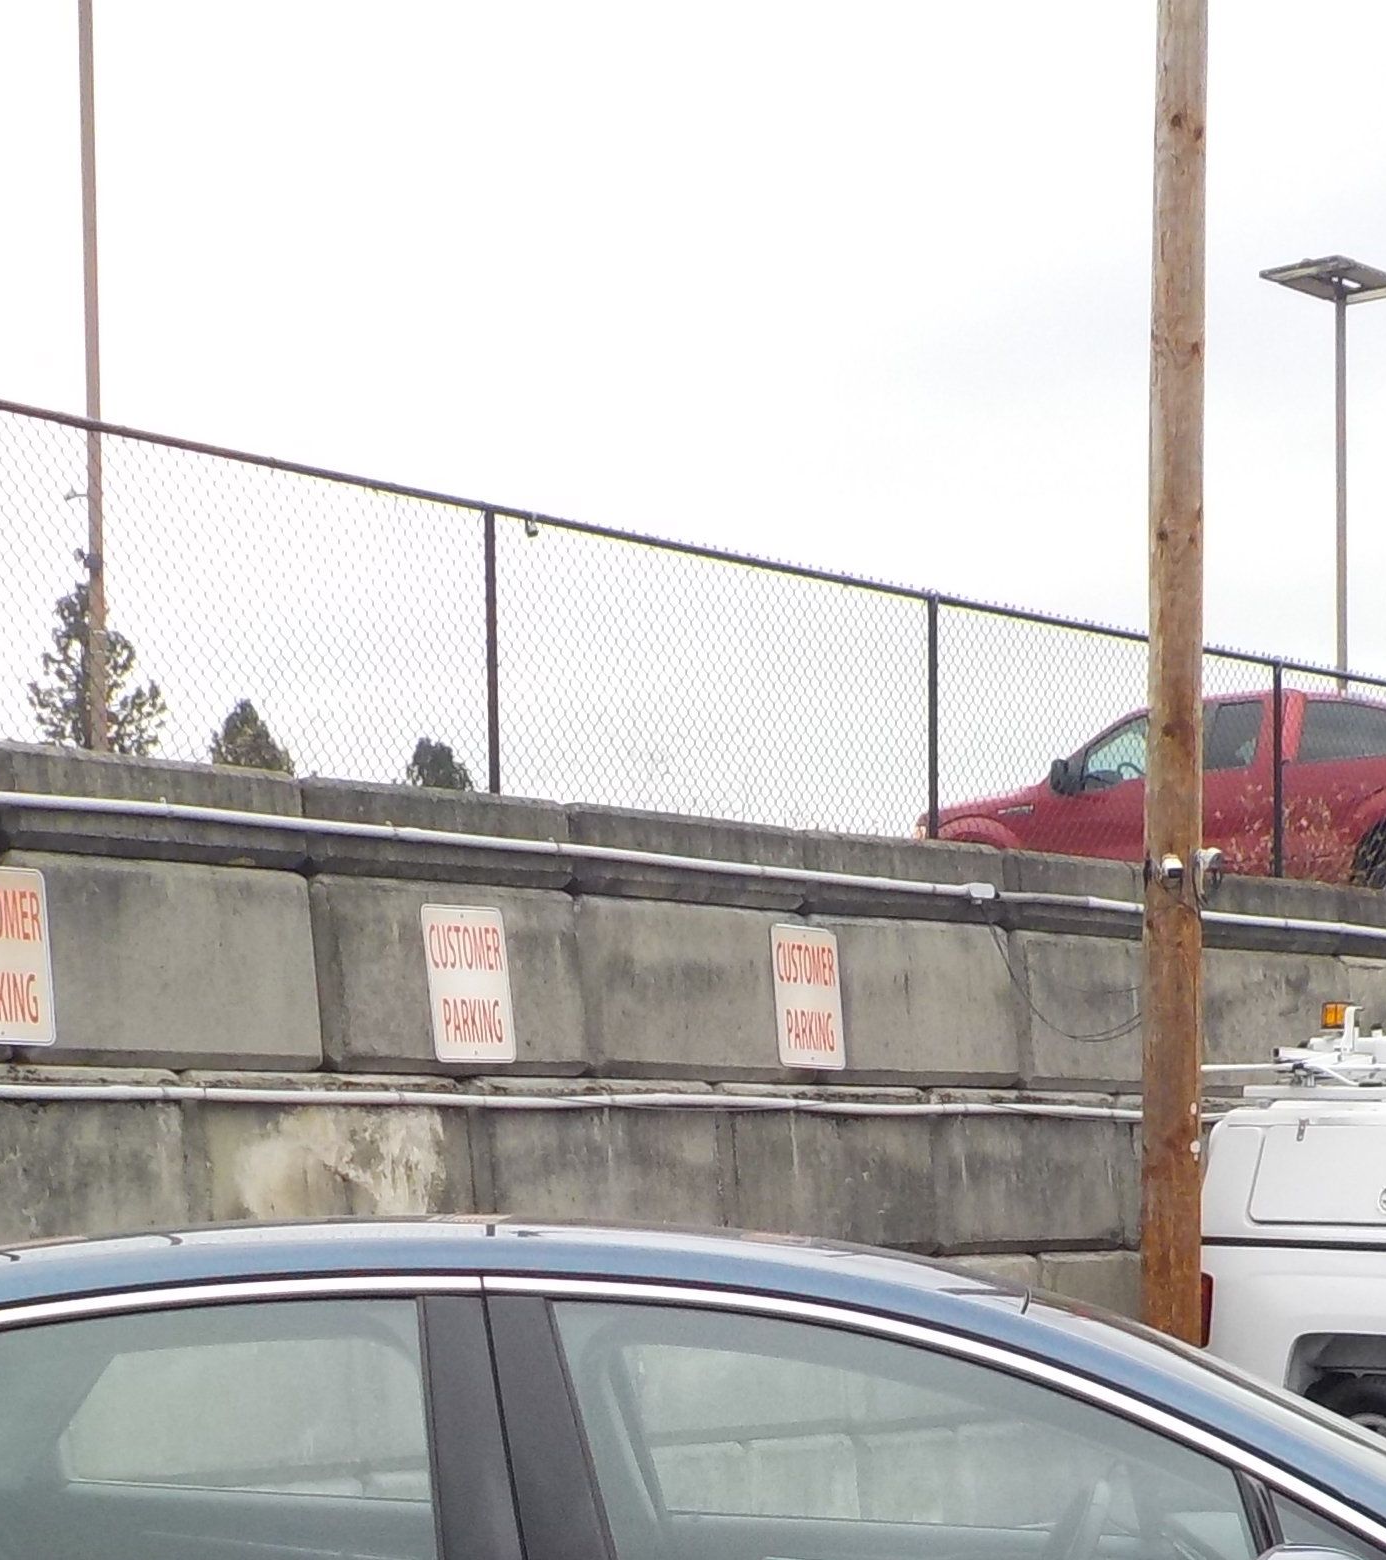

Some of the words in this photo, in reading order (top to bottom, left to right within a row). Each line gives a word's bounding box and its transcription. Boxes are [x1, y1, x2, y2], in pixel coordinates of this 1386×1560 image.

[429, 924, 503, 971] CUSTOMER
[776, 941, 835, 986] CUSTOMER
[442, 998, 503, 1043] PARKING
[786, 1008, 835, 1051] PARKING
